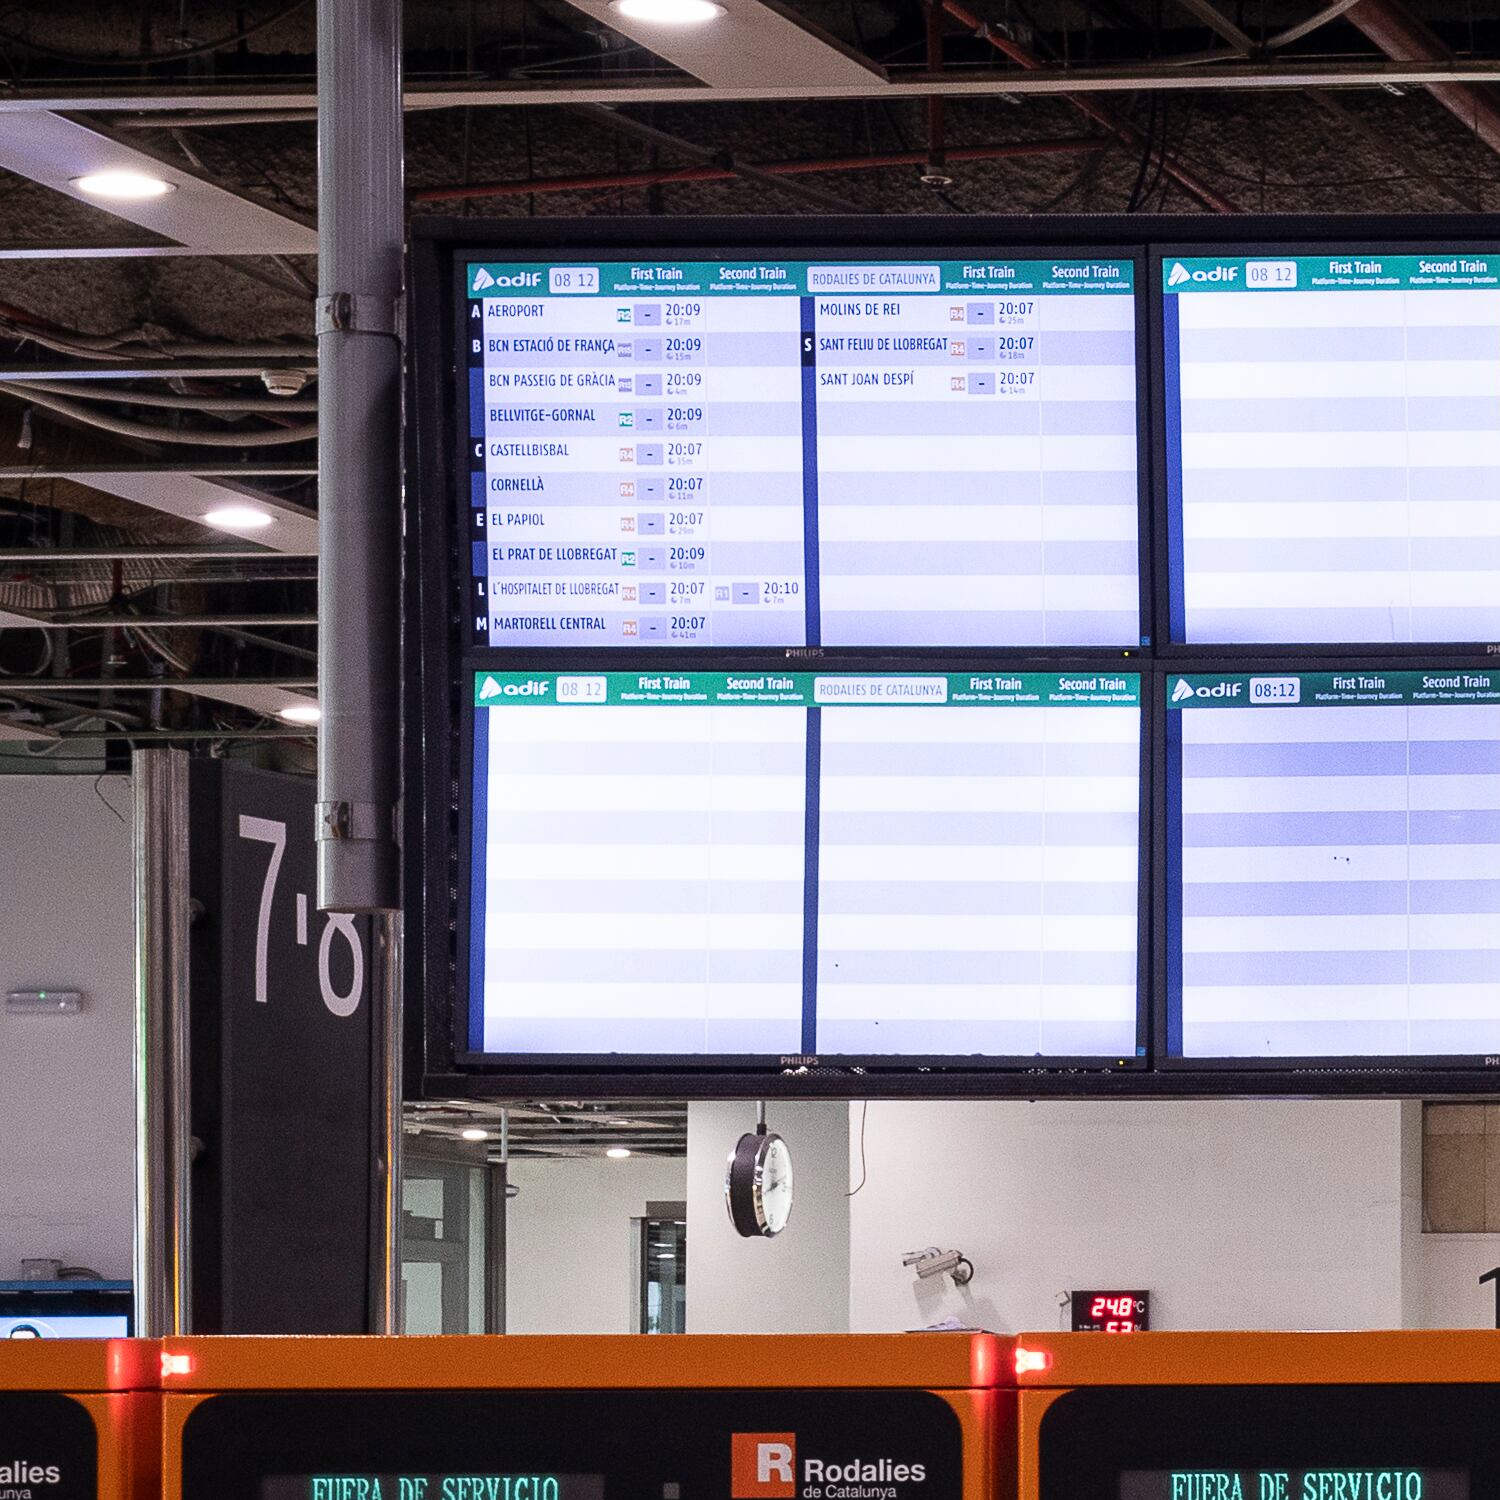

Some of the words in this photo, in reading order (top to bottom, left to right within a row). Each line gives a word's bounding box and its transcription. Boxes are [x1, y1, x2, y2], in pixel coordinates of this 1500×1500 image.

[631, 268, 654, 280] First
[657, 268, 683, 280] Train
[720, 268, 757, 280] Second
[760, 268, 786, 279] Train
[963, 267, 986, 278] First
[988, 267, 1015, 278] Train
[1052, 266, 1090, 278] Second
[1092, 266, 1119, 278] Train
[496, 271, 542, 288] adif
[554, 274, 571, 287] 08
[578, 274, 594, 287] 12
[813, 273, 860, 286] RODALIES
[862, 273, 876, 285] DE
[879, 272, 936, 285] CATALUNYA
[471, 305, 480, 318] A
[488, 305, 544, 317] AEROPORT
[666, 305, 700, 317] 20:09
[820, 303, 862, 316] MOLINS
[865, 303, 878, 316] DE
[882, 303, 900, 316] REI
[999, 302, 1033, 315] 20:07
[472, 340, 481, 353] B
[489, 339, 510, 352] BCN
[513, 336, 554, 352] ESTACIÓ
[557, 339, 571, 352] DE
[575, 339, 615, 355] FRANÇA
[666, 339, 701, 352] 20:09
[804, 338, 812, 351] S
[820, 338, 845, 351] SANT
[848, 338, 874, 351] FELIU
[878, 338, 891, 350] DE
[894, 338, 948, 350] LLOBREGAT
[999, 338, 1034, 350] 20:07
[490, 375, 510, 387] BCN
[514, 375, 557, 387] PASSEIG
[560, 375, 573, 387] DE
[576, 371, 615, 386] GRÀCIA
[667, 374, 701, 386] 20:09
[821, 374, 848, 386] SANT
[852, 374, 880, 386] JOAN
[883, 370, 914, 385] DESPÍ
[1000, 372, 1034, 384] 20:07
[490, 409, 596, 422] BELLVITGE-GORNAL
[667, 409, 702, 421] 20:09
[475, 444, 483, 457] C
[491, 443, 569, 457] CASTELLBISBAL
[668, 443, 702, 456] 20:07
[491, 475, 544, 492] CORNELLÀ
[668, 478, 703, 490] 20:07
[476, 514, 484, 526] E
[492, 514, 504, 526] EL
[508, 514, 544, 526] PAPIOL
[669, 513, 703, 525] 20:07
[493, 548, 505, 562] EL
[508, 548, 536, 562] PRAT
[539, 548, 554, 561] DE
[557, 548, 617, 561] LLOBREGAT
[670, 548, 704, 560] 20:09
[478, 583, 485, 596] L
[555, 583, 568, 595] DE
[570, 583, 619, 595] LLOBREGAT
[670, 583, 704, 595] 20:07
[764, 583, 798, 594] 20:10
[476, 617, 487, 630] M
[494, 617, 556, 630] MARTORELL
[559, 617, 606, 630] CENTRAL
[671, 618, 705, 630] 20:07
[1333, 677, 1356, 689] First
[1358, 677, 1385, 689] Train
[1423, 676, 1460, 688] Second
[1463, 675, 1490, 687] Train
[1196, 682, 1242, 698] adif
[1254, 683, 1295, 697] 08:12
[803, 1459, 925, 1483] Rodalies
[803, 1485, 821, 1499] de
[826, 1485, 896, 1500] Catalunya
